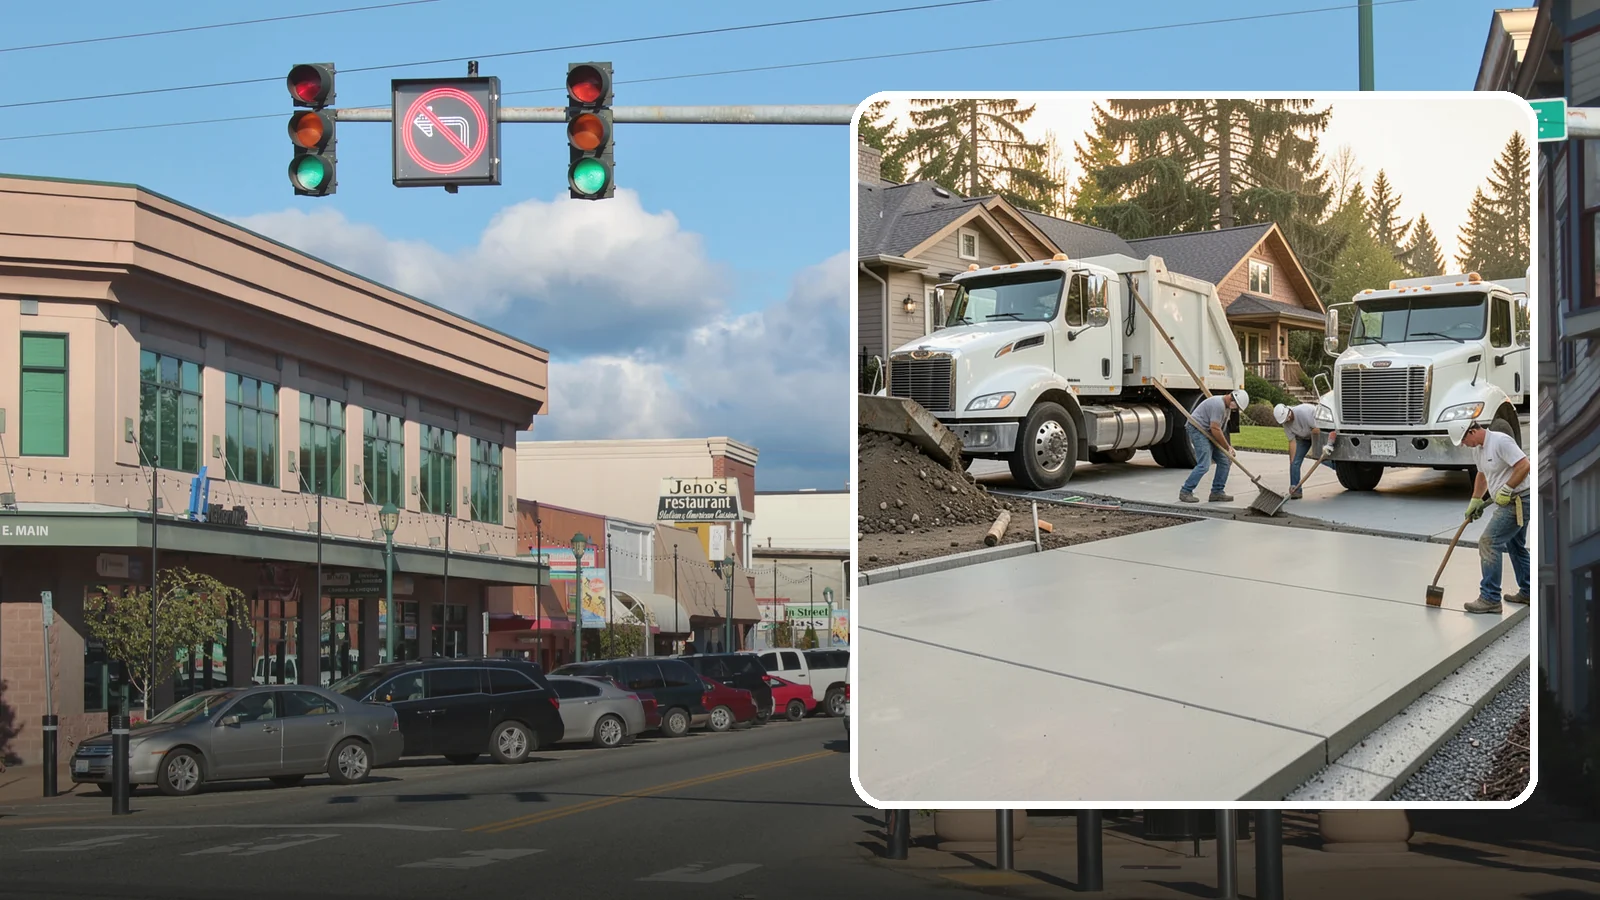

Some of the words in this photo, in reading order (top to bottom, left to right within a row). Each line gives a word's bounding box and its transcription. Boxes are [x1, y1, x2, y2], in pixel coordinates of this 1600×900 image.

[670, 480, 727, 494] Jeno's
[665, 496, 731, 509] restaurant
[659, 510, 681, 519] Italian
[686, 510, 715, 519] American
[715, 510, 737, 519] Cuisine
[2, 525, 13, 536] E.
[15, 525, 49, 536] MAIN
[785, 607, 795, 617] in
[797, 608, 829, 617] Street
[791, 619, 823, 627] lass
